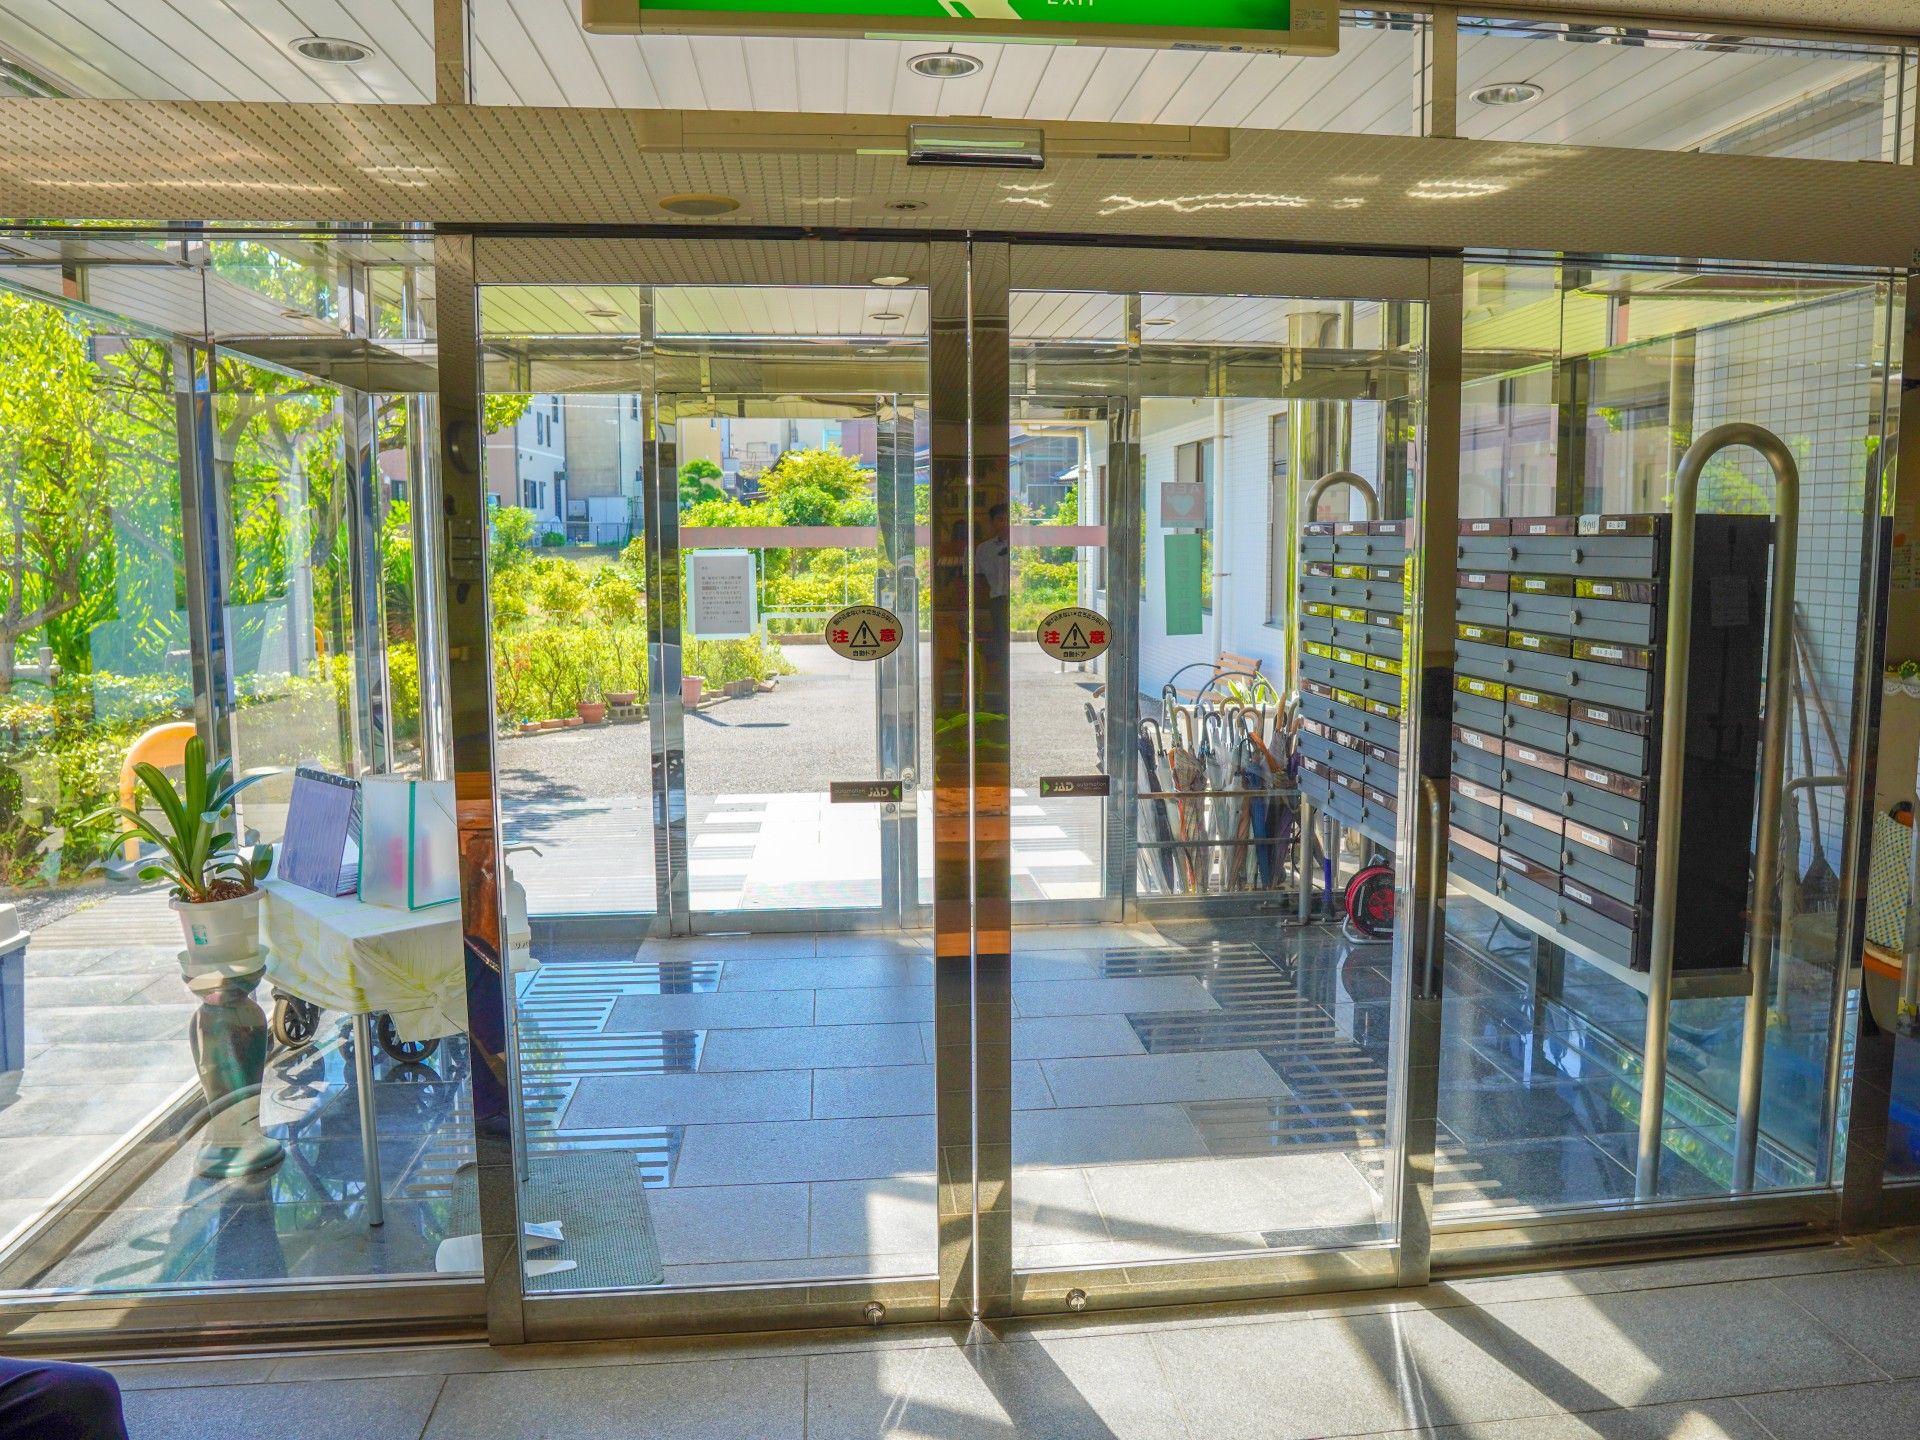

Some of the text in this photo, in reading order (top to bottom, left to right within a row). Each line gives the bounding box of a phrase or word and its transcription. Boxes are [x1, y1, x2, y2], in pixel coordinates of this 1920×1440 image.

[1582, 520, 1596, 532] 304
[867, 787, 890, 797] JAD
[1053, 781, 1074, 792] JAD
